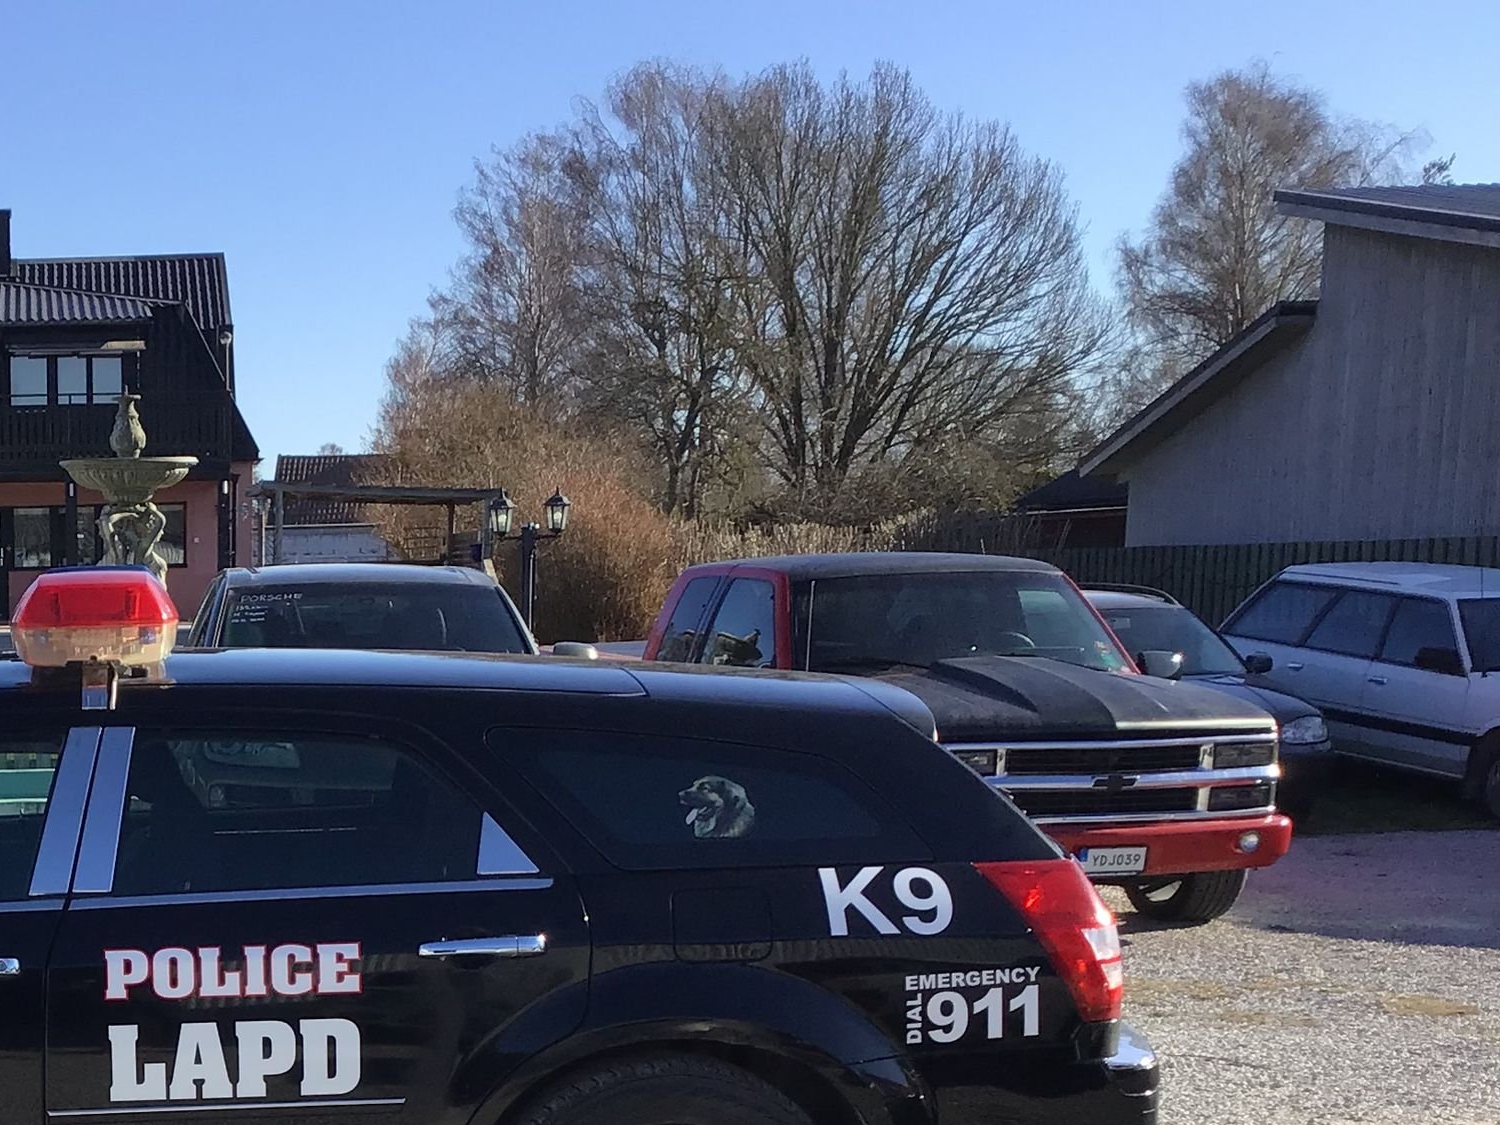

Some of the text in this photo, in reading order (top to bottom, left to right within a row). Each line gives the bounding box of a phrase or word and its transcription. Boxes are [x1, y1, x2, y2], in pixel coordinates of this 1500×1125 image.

[240, 593, 303, 603] PORSCHE
[1092, 853, 1142, 868] YDJ039
[817, 866, 953, 936] K9
[103, 941, 363, 1001] POLICE
[905, 966, 1041, 991] EMERGENCY
[906, 992, 922, 1045] DIAL
[926, 984, 1040, 1043] 911
[107, 1017, 362, 1102] LAPD
